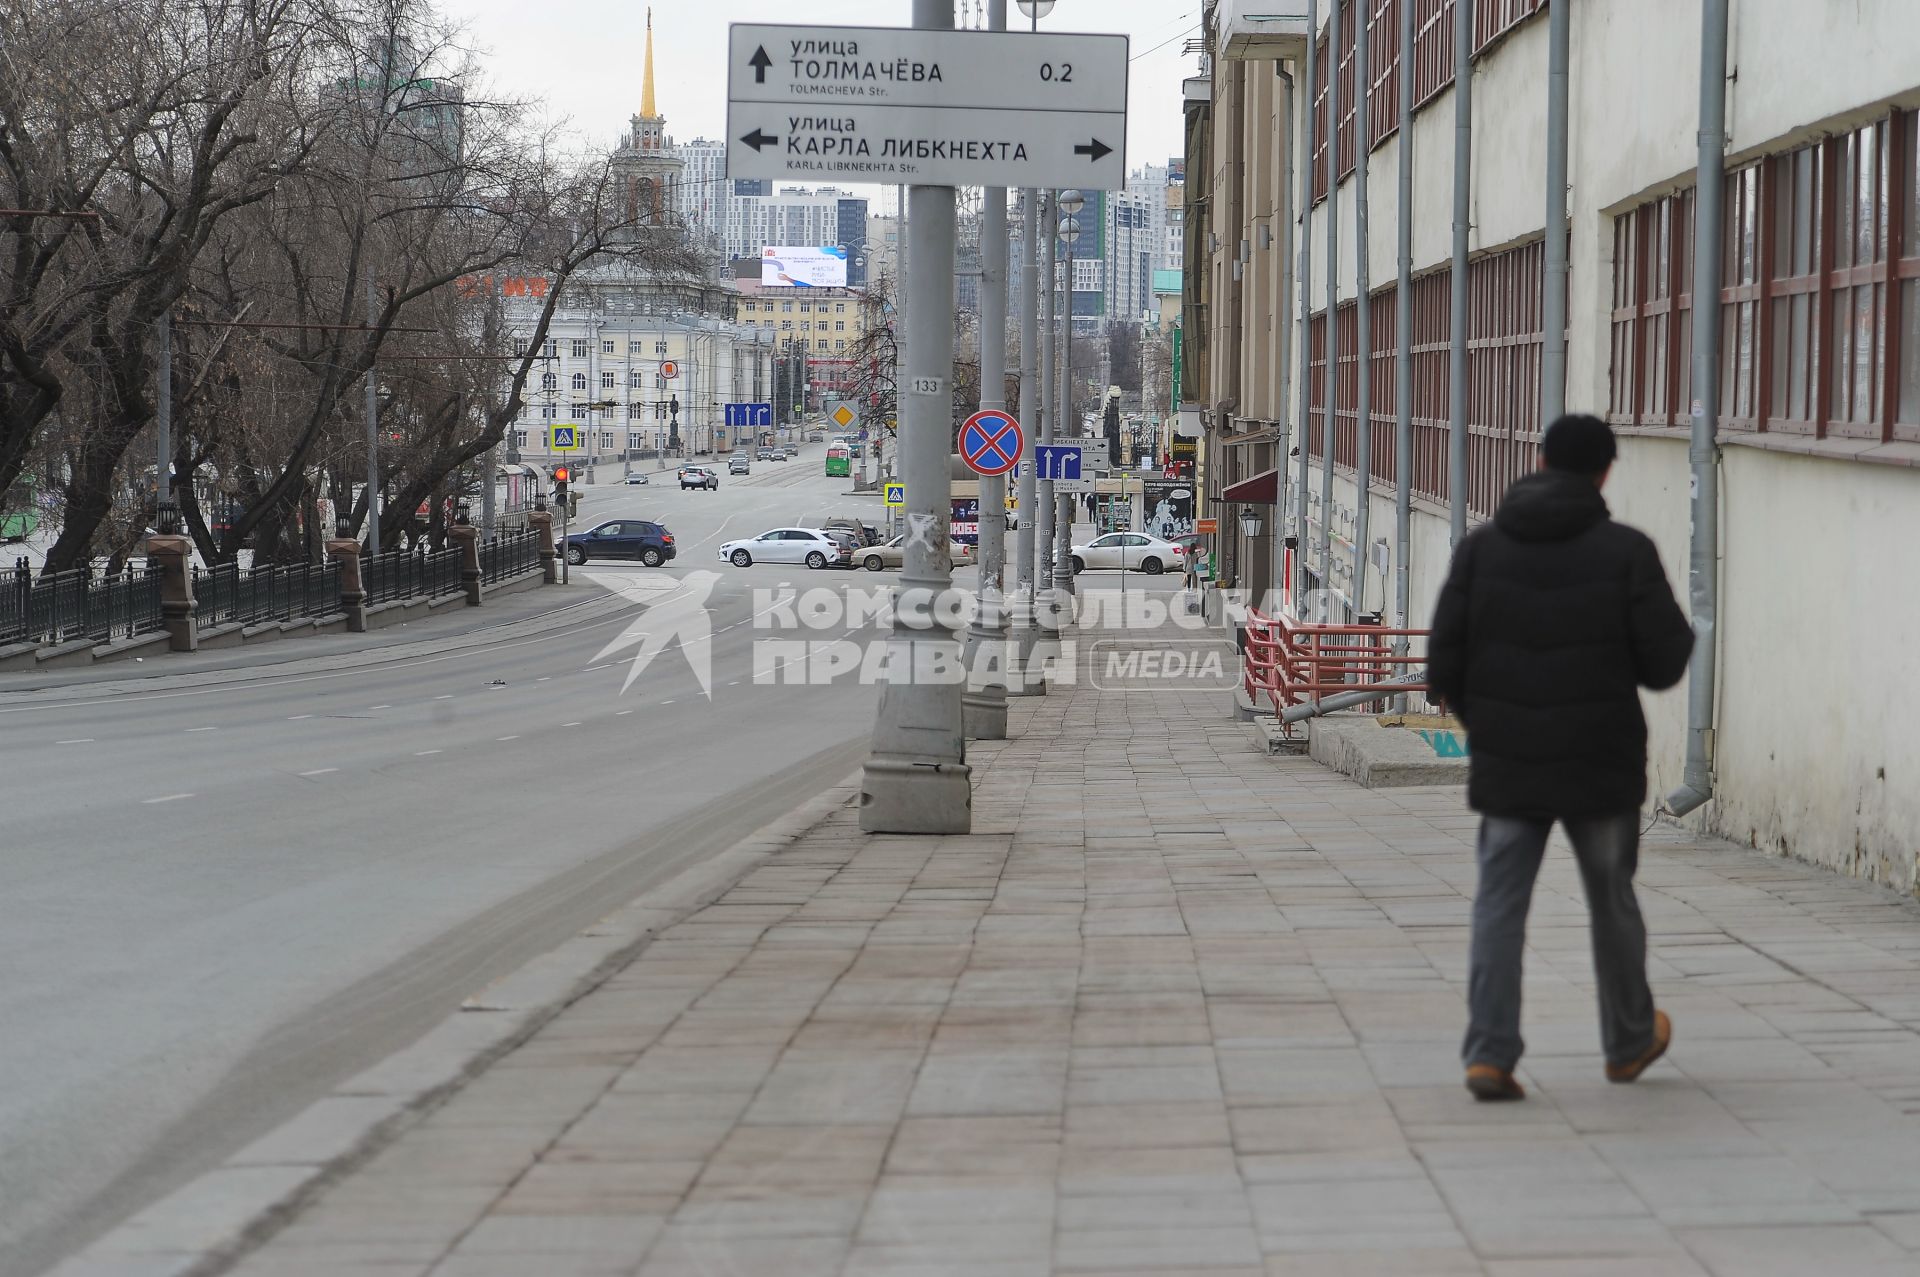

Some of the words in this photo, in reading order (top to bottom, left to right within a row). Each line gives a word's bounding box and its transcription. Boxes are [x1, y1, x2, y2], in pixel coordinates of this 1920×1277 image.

[790, 39, 858, 57] улица
[790, 58, 943, 82] ТОЛМАЧЁВА
[1039, 62, 1073, 82] 0.2
[789, 84, 865, 95] TOLMACHEVA
[869, 86, 889, 97] Str.
[788, 116, 855, 134] улица
[787, 136, 871, 157] КАРЛА
[881, 138, 1028, 162] ЛИБКНЕХТА
[786, 160, 824, 170] KARLA
[827, 161, 896, 173] LIBKNEKHTA
[899, 163, 920, 174] Str.
[914, 379, 937, 393] 133
